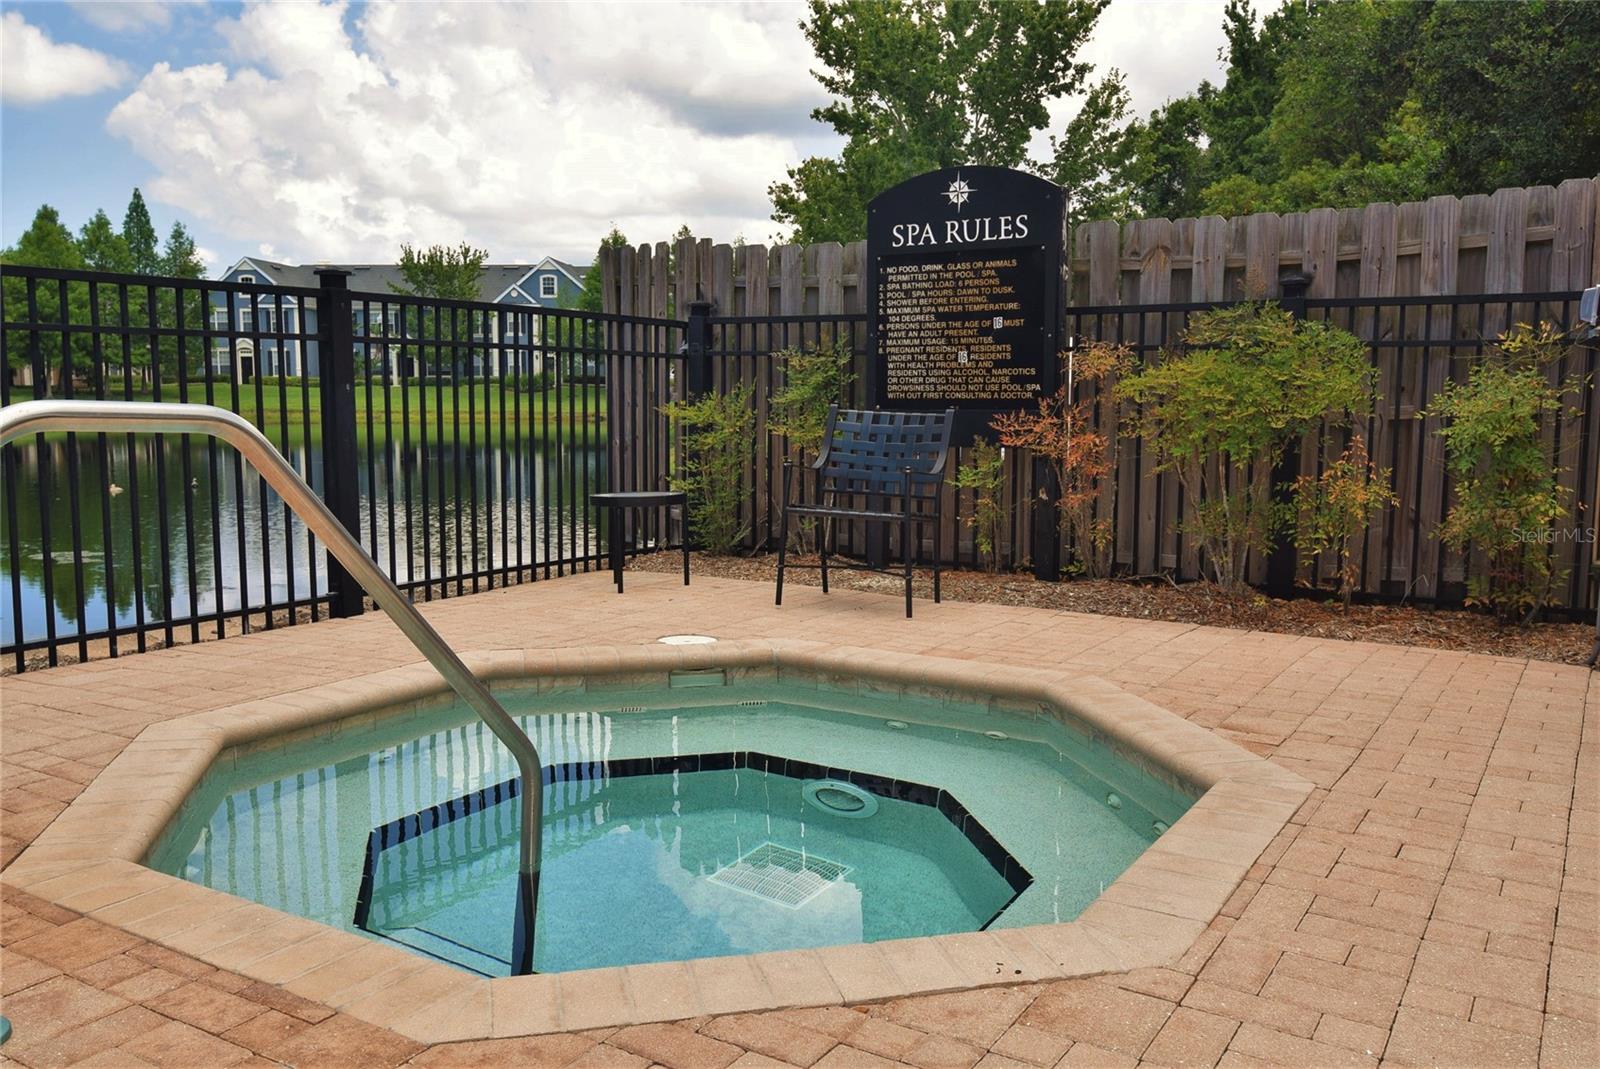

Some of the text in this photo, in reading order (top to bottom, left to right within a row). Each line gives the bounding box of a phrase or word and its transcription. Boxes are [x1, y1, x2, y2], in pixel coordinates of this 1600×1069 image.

[892, 215, 1028, 247] SPA RULES
[985, 259, 1017, 268] ANIMALS
